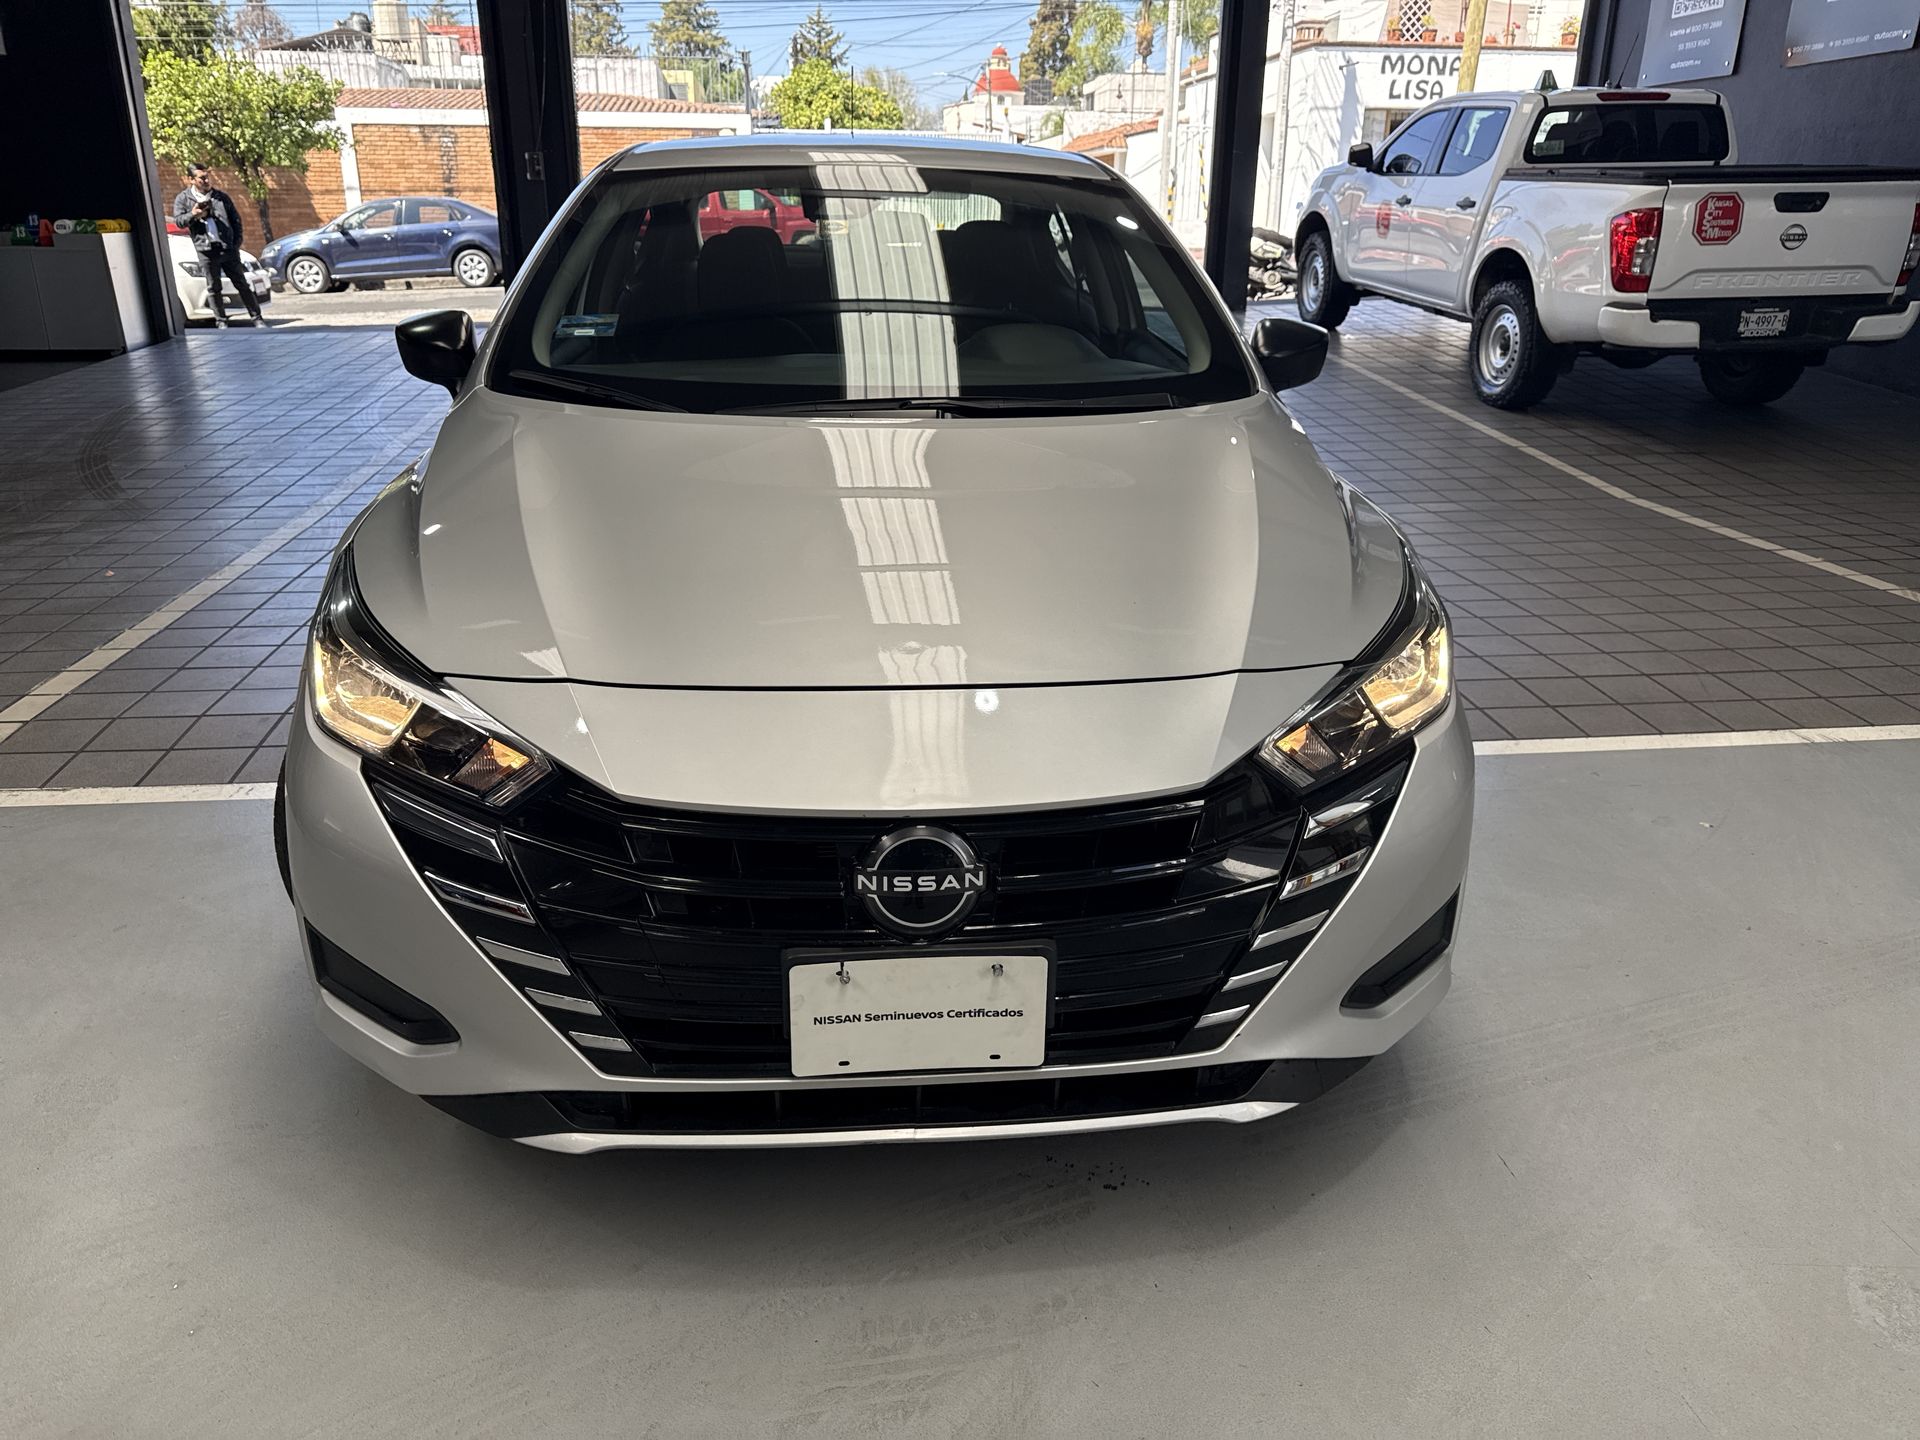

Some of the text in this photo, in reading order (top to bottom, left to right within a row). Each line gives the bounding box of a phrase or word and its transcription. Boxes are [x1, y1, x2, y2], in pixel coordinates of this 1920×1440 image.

[1381, 55, 1461, 76] MONA
[1389, 80, 1443, 100] LISA
[28, 215, 38, 226] 13
[15, 226, 26, 238] 13
[1694, 271, 1862, 289] FRONTIER
[1740, 314, 1788, 328] PN-4997-B
[857, 870, 983, 892] NISSAN
[813, 1008, 1024, 1026] NISSAN Seminuevos Certificados
